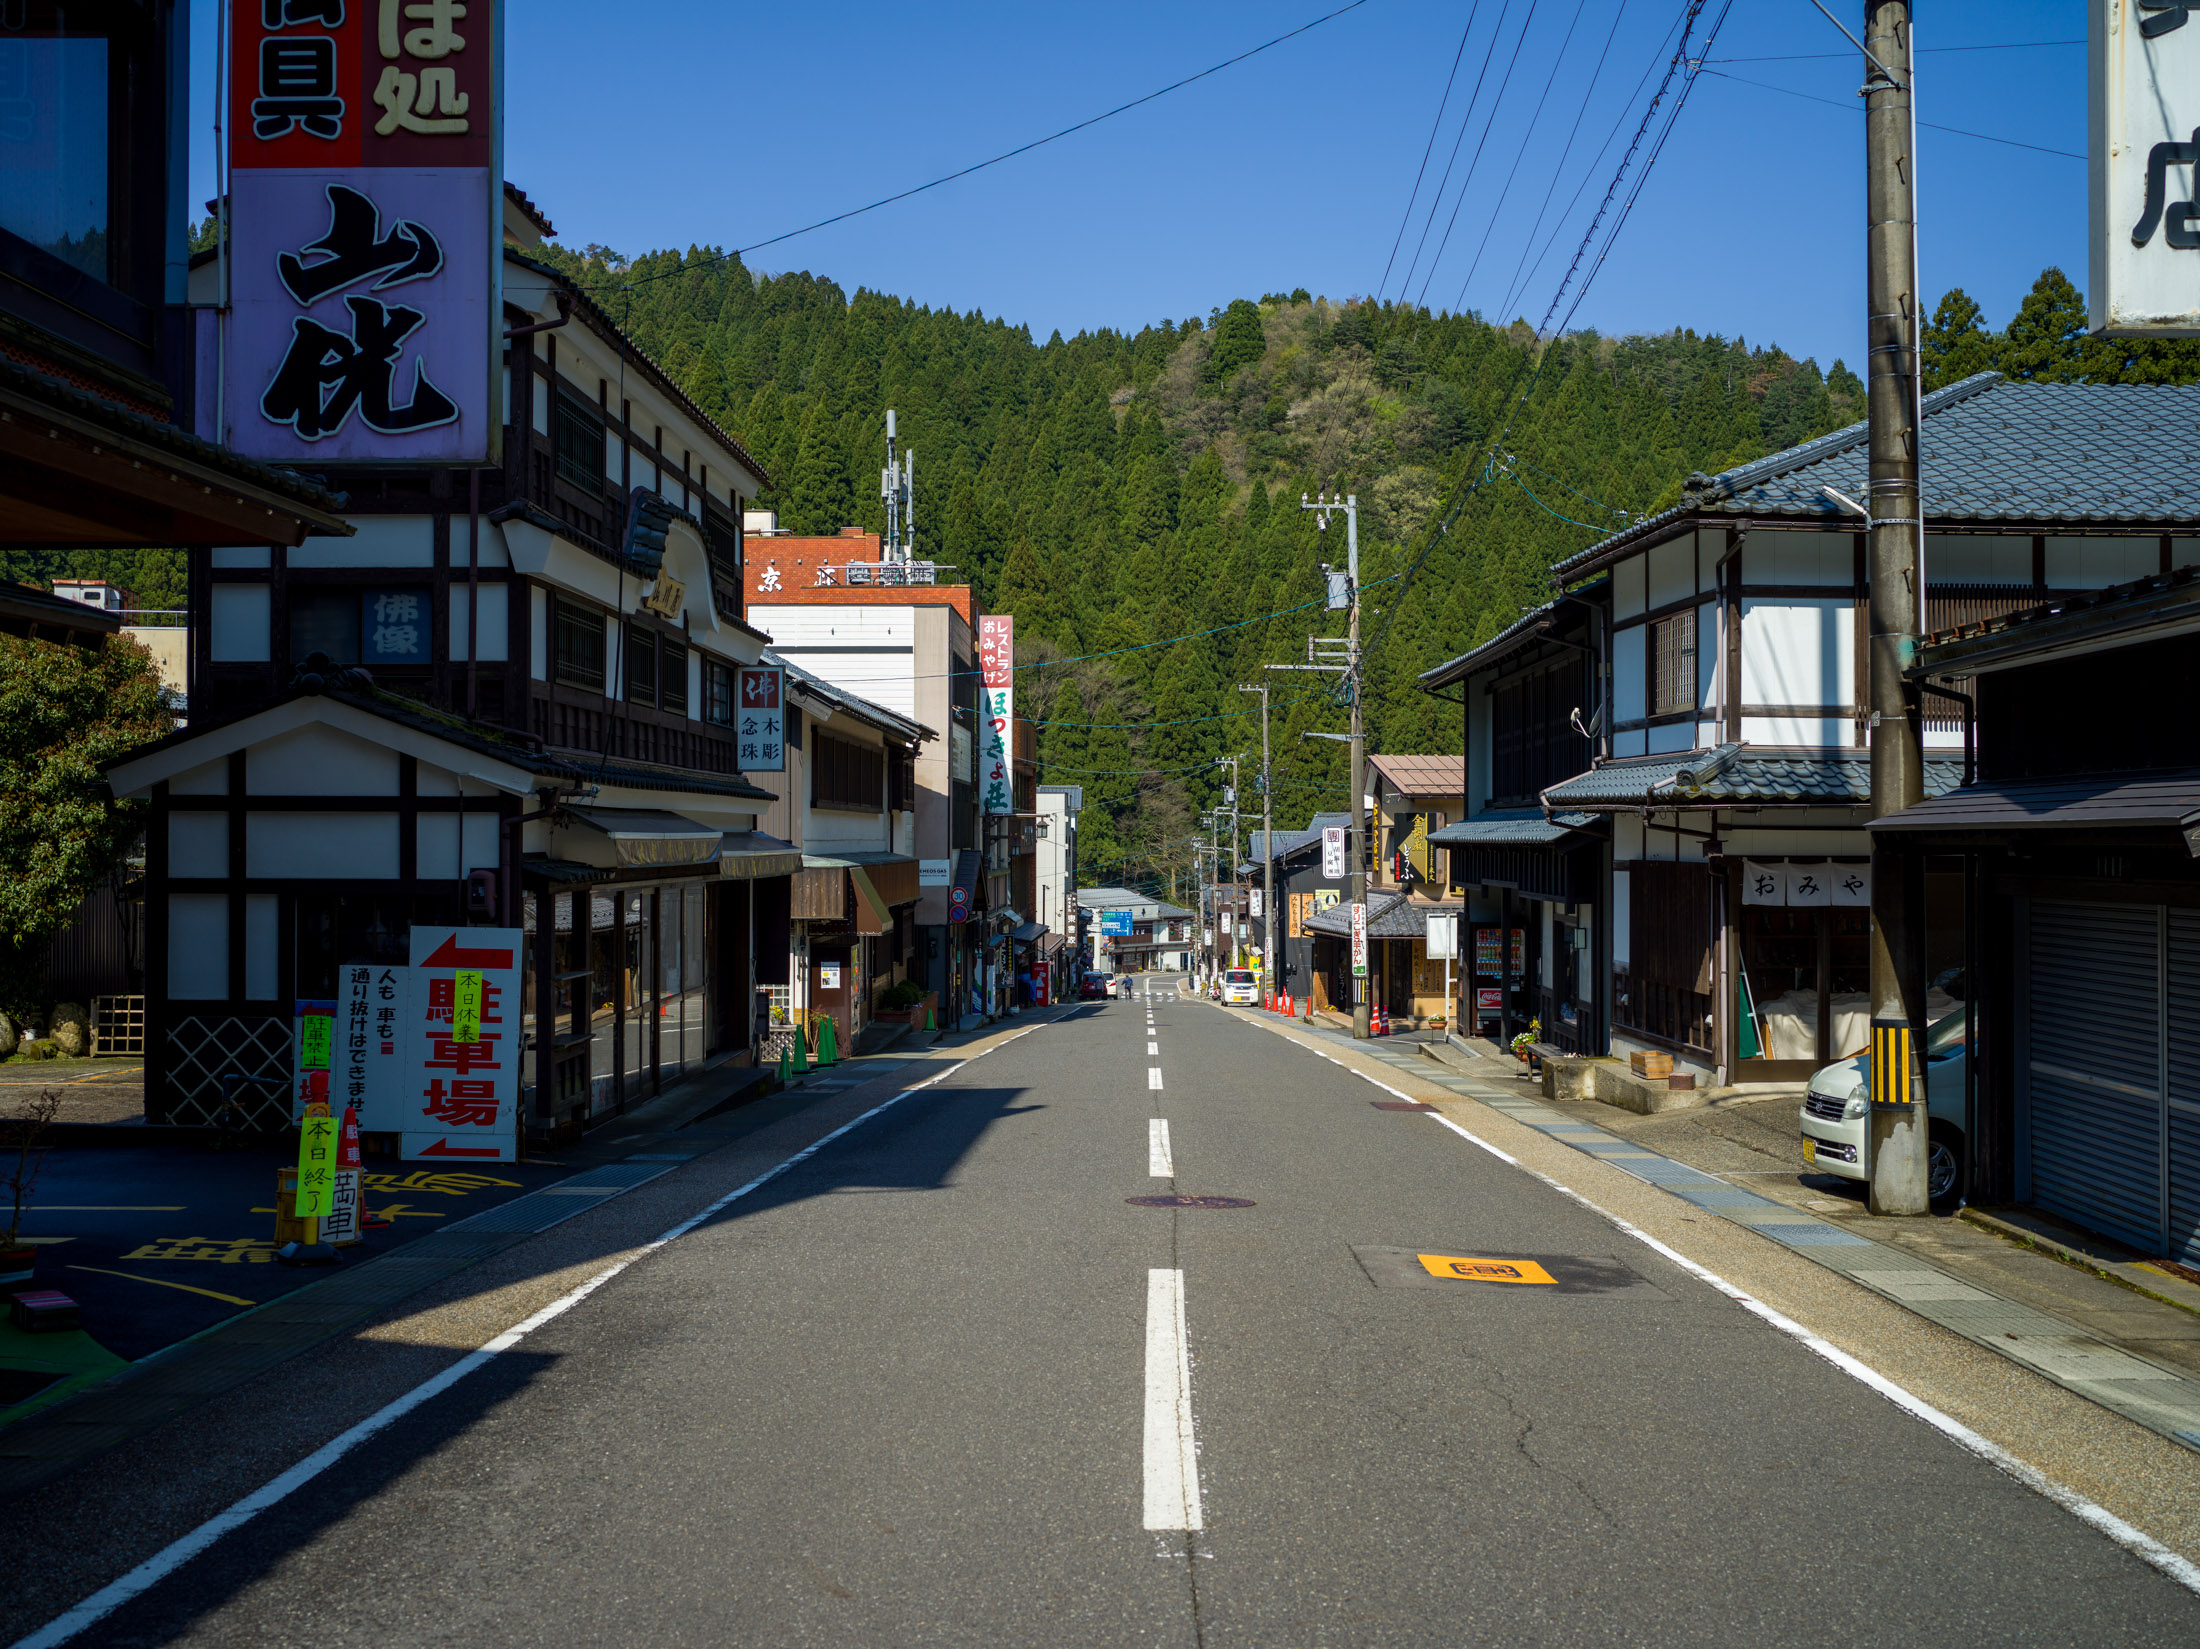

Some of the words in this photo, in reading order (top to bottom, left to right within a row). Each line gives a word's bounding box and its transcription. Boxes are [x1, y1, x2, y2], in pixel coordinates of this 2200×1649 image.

[251, 0, 346, 140] 具
[983, 620, 996, 684] おみやげ
[997, 620, 1009, 684] レストラン
[741, 717, 758, 760] 念珠
[762, 717, 780, 760] 木彫
[1401, 843, 1414, 880] どうふ
[1755, 875, 1864, 896] おみや
[954, 892, 964, 900] 30
[456, 973, 479, 1042] 本日休業
[304, 1016, 327, 1068] 駐車禁止
[304, 1120, 333, 1212] 本日終了
